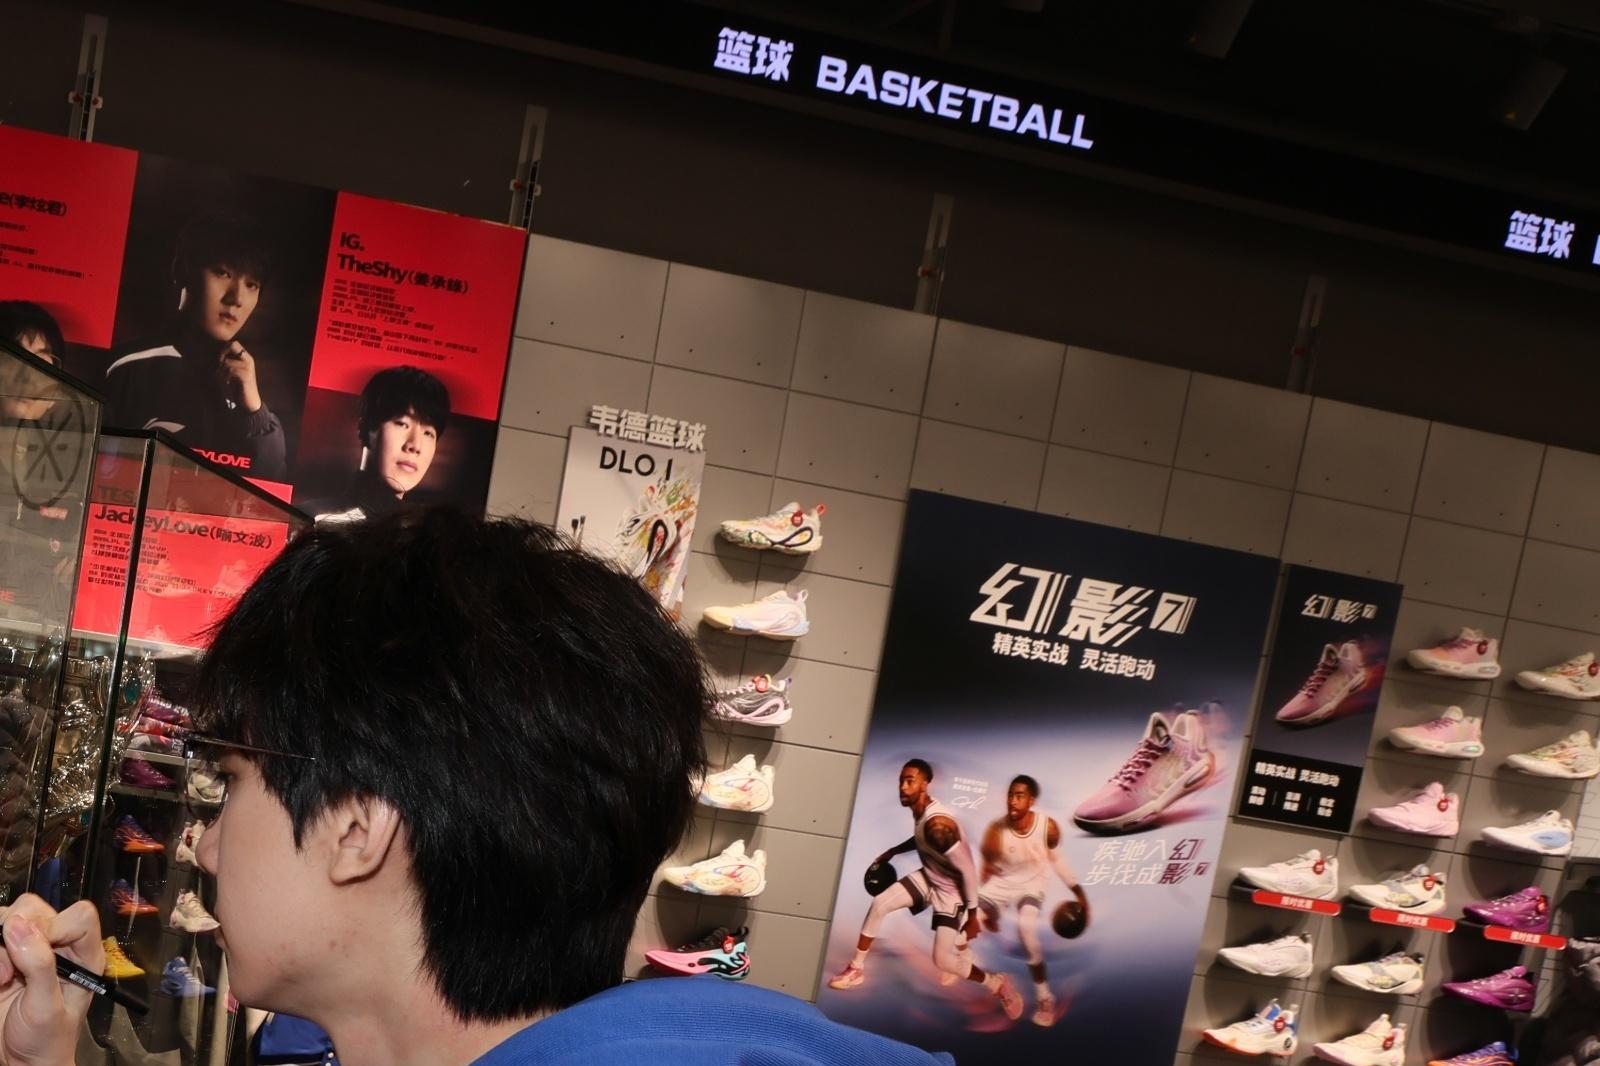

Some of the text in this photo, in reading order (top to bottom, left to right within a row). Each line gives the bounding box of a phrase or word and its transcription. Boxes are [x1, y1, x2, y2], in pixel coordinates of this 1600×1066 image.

[714, 27, 1094, 149] 篮球 BASKETBALL
[339, 231, 366, 253] IG.
[1504, 210, 1575, 259] 篮球
[590, 404, 706, 452] 韦德篮球
[599, 446, 655, 477] DLO
[991, 632, 1157, 681] 精英实战 灵活跑动
